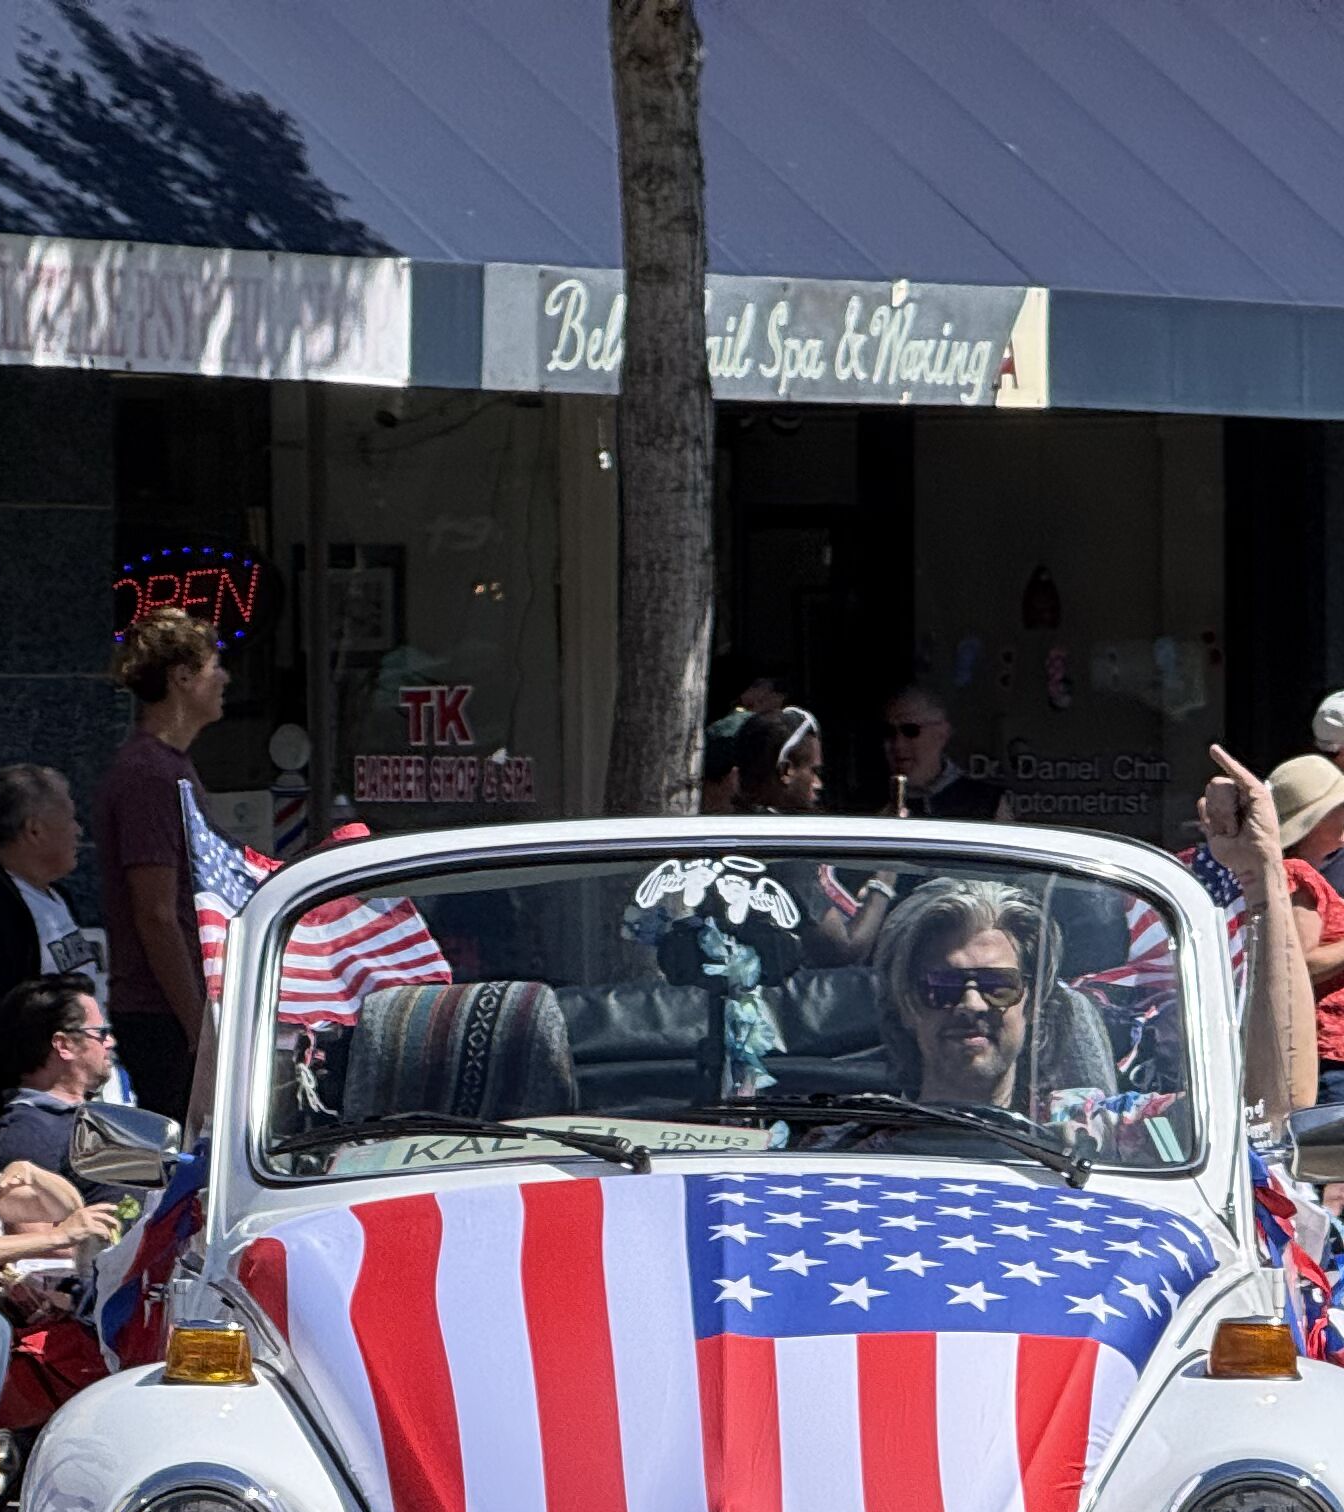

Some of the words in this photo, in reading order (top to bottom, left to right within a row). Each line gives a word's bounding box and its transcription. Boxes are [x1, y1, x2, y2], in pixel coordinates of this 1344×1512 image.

[545, 279, 625, 372] Bel
[704, 289, 754, 378] ail
[759, 301, 826, 396] Spa
[835, 296, 868, 380] &
[870, 303, 993, 405] Waxing
[399, 684, 474, 746] TK
[354, 755, 427, 802] BARBER
[431, 755, 479, 802] SHOP
[502, 756, 536, 802] SPA
[968, 754, 1005, 779] Dr.
[1016, 754, 1099, 780] Daniel
[1113, 754, 1171, 780] Chin
[660, 1131, 749, 1147] DNH3
